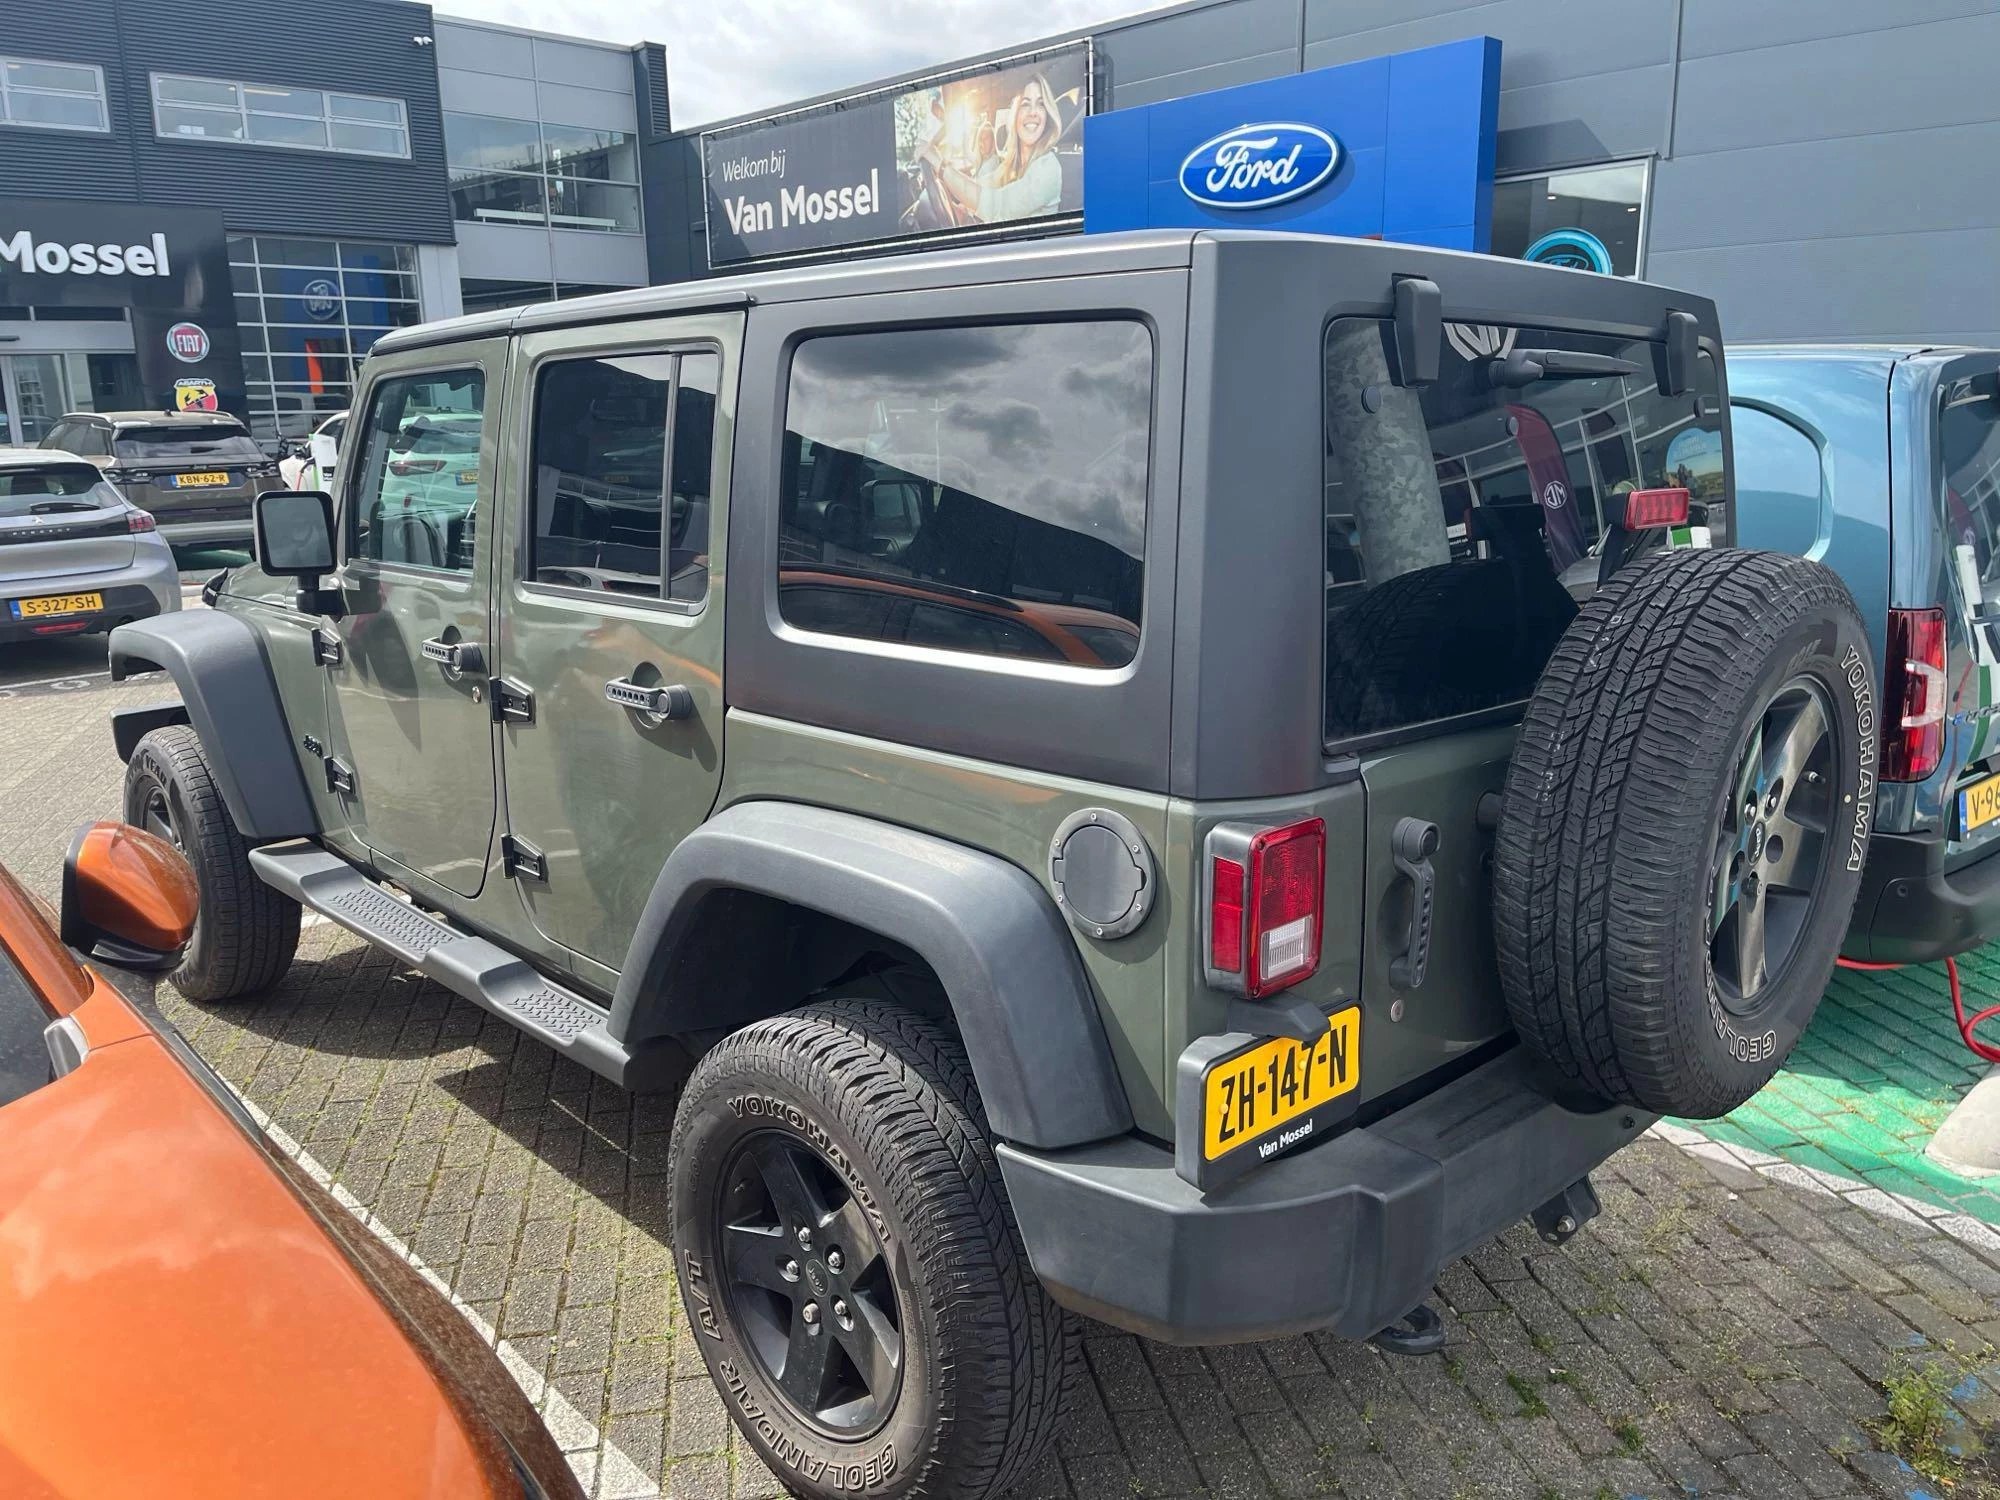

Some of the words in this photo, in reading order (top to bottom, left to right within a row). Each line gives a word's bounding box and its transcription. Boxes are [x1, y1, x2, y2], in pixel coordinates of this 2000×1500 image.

[722, 156, 769, 183] Welkom
[770, 149, 787, 179] bij
[1206, 136, 1303, 193] Ford
[724, 195, 774, 235] Van
[780, 168, 880, 228] Mossel
[0, 230, 171, 277] Mossel
[176, 334, 201, 353] FIAT
[179, 474, 226, 485] KBN-62-R
[26, 596, 97, 614] S-327-SH
[1841, 645, 1875, 872] YOKOHAMA
[1219, 1024, 1347, 1143] ZH-147-N
[1258, 1141, 1278, 1158] Van
[1280, 1118, 1313, 1149] Mossel
[726, 1094, 892, 1244] YOKOHAMA
[684, 1248, 723, 1341] A/T
[719, 1356, 898, 1491] GEOLANDAR
